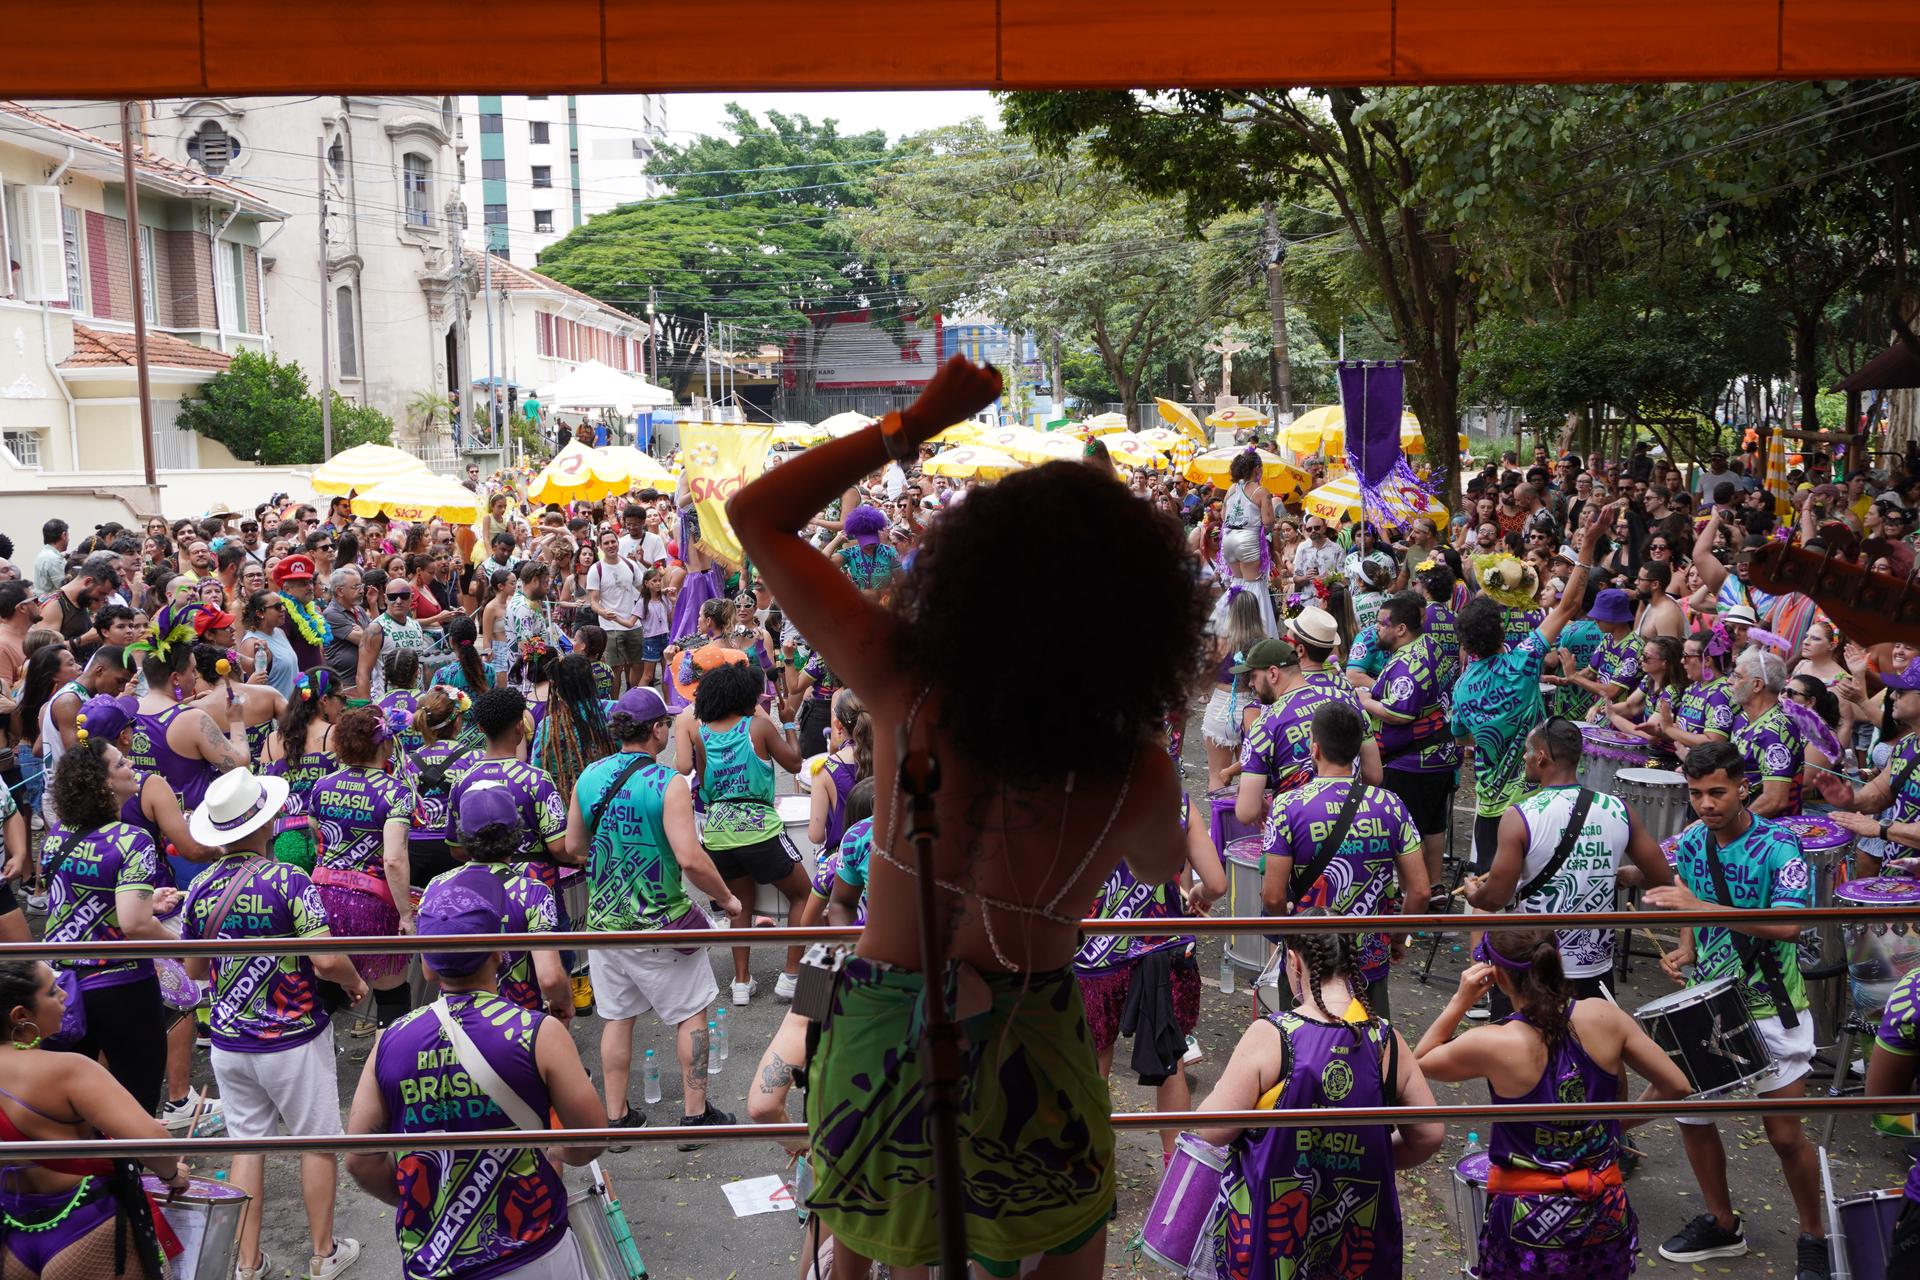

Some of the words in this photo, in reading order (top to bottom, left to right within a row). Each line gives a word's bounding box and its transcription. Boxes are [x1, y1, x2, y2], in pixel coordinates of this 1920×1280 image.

[393, 507, 424, 519] SKOL
[1314, 503, 1337, 518] SKOL
[1505, 621, 1535, 632] ASIL
[1571, 644, 1597, 655] BRA
[1460, 685, 1518, 716] BRASIL
[1501, 695, 1523, 713] DA
[336, 780, 366, 793] BATERIA
[320, 790, 375, 811] BRASIL
[355, 809, 373, 822] DA
[591, 803, 643, 824] BASIL
[622, 823, 643, 837] DA
[43, 835, 103, 862] BRSIL
[1369, 838, 1390, 853] DA
[1570, 841, 1612, 858] ASIL
[76, 860, 100, 878] DA
[1592, 858, 1611, 870] DA
[1694, 858, 1759, 885] BSIL
[590, 849, 647, 921] LIBERDADE
[1734, 885, 1759, 900] DA
[194, 893, 273, 919] BRSIL
[47, 895, 108, 942] RDADE
[246, 915, 273, 930] DA
[417, 1046, 461, 1071] BATE
[400, 1071, 488, 1105] BRASI
[404, 1106, 419, 1126] A
[467, 1098, 503, 1118] DA
[1295, 1127, 1366, 1155] BRASIL
[1296, 1153, 1309, 1168] A
[1338, 1154, 1361, 1171] DA
[416, 1147, 514, 1271] LIBERDADE
